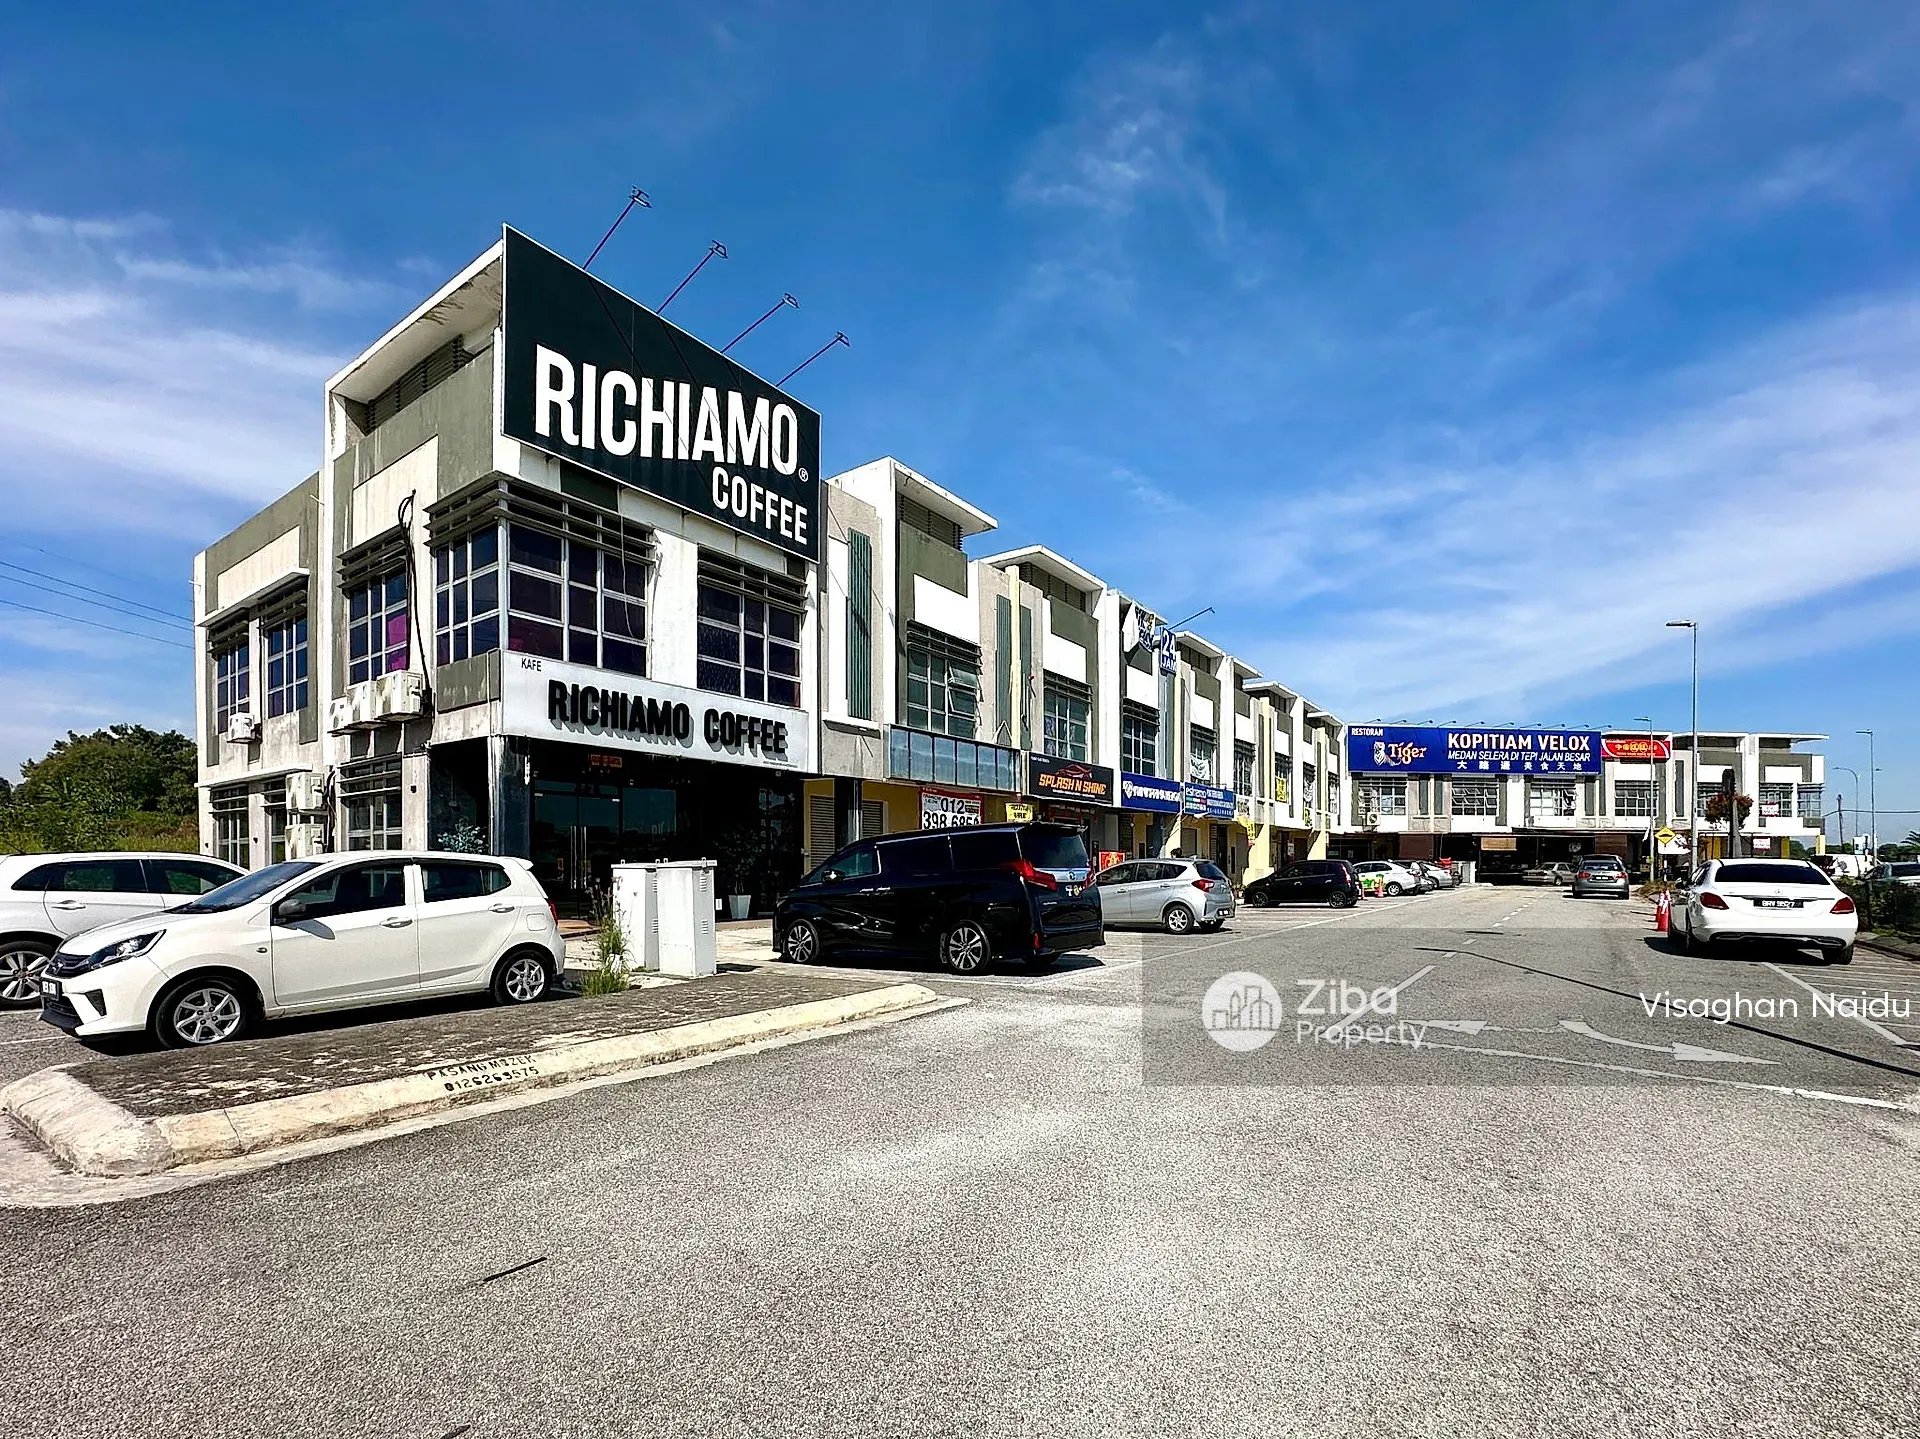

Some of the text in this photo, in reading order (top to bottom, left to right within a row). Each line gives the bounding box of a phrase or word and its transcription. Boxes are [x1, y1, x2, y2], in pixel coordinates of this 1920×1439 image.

[535, 344, 798, 475] RICHIAMO
[712, 466, 808, 545] COFFEE
[1163, 629, 1176, 661] 24
[521, 657, 542, 672] KAFE
[548, 679, 787, 756] RICHIAMO COFFEE
[1351, 728, 1384, 737] RESTORAN
[1448, 733, 1591, 751] KOPITIAM VELOX
[1388, 742, 1427, 765] Tiger
[1448, 750, 1591, 762] MEDAN SELERA DI TEPI JALAN BESAR
[1039, 774, 1075, 791] SPLASH
[1075, 780, 1083, 792] N
[1083, 782, 1107, 795] SHINE
[940, 798, 965, 814] 012
[428, 1063, 487, 1080] PASANG
